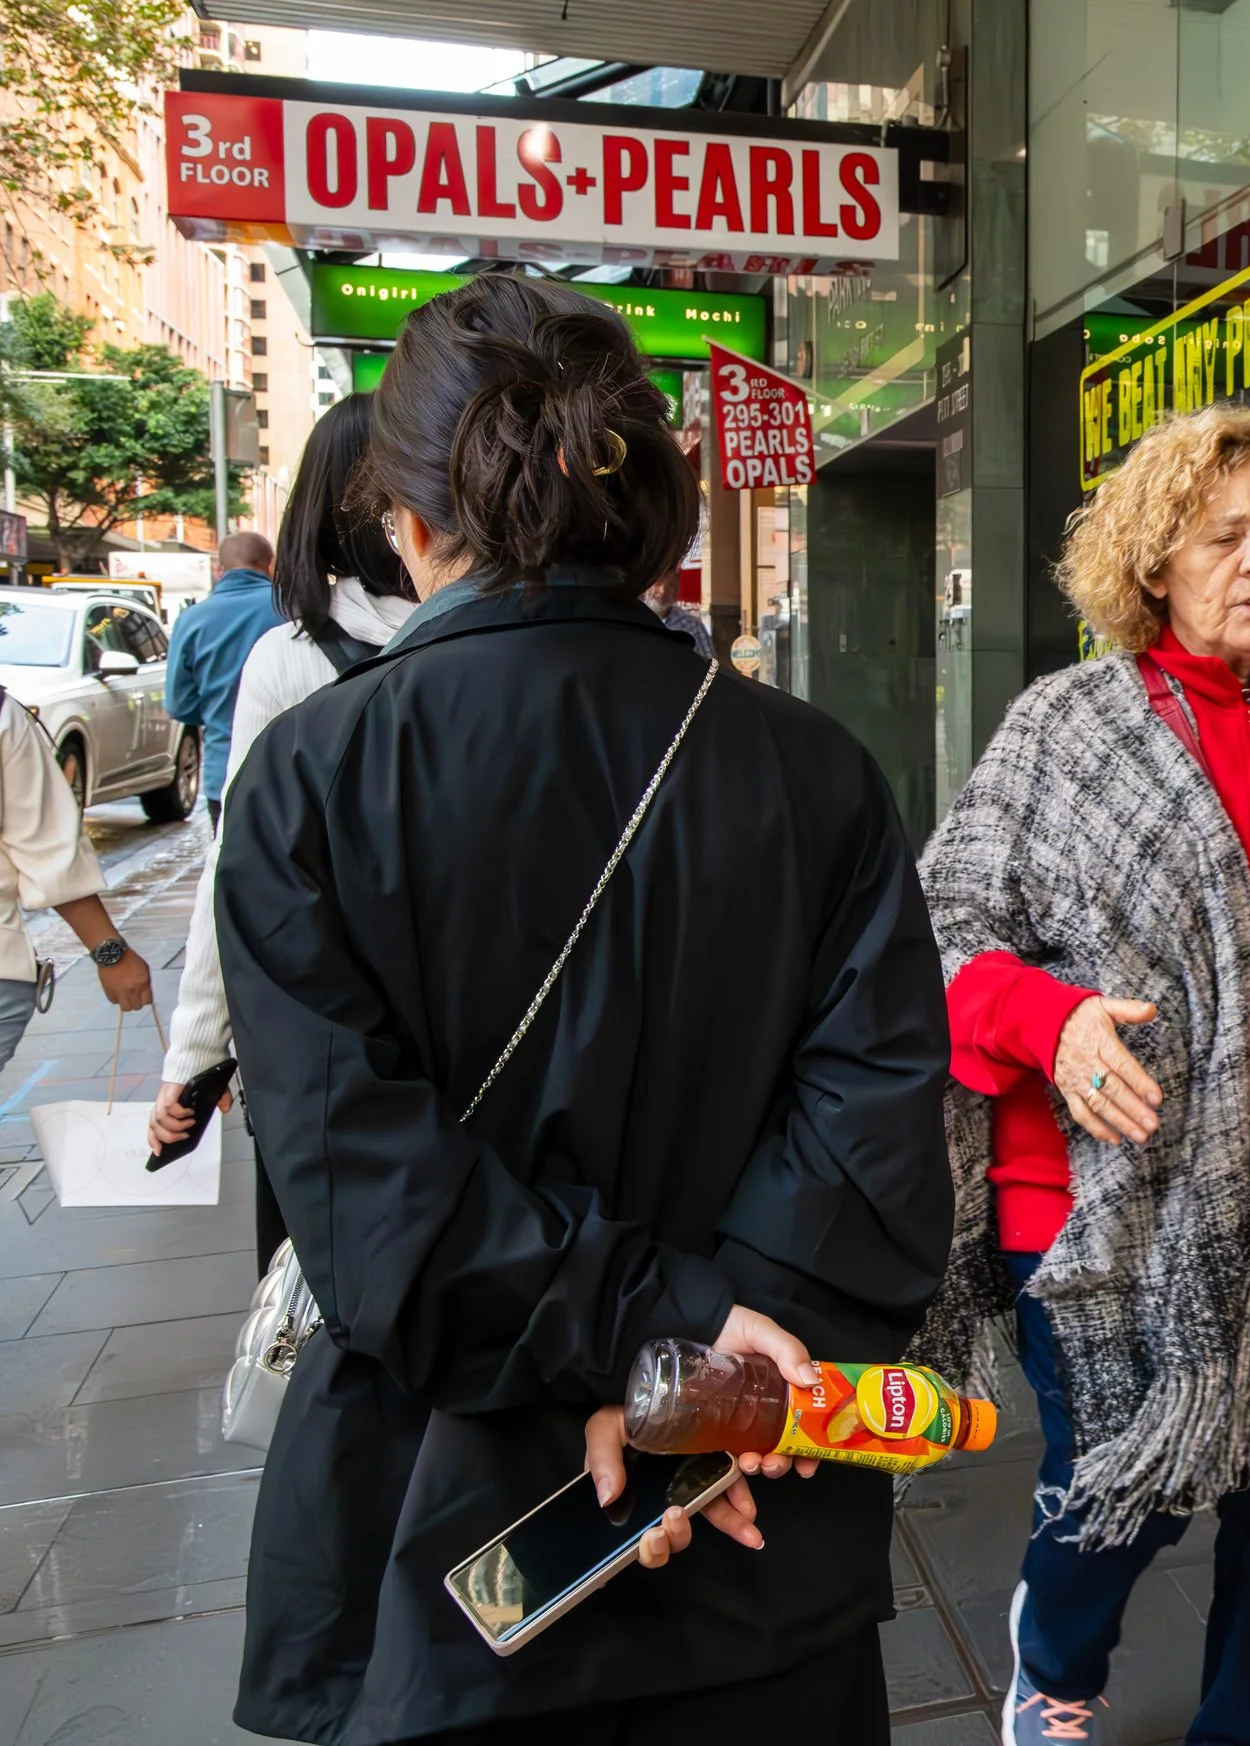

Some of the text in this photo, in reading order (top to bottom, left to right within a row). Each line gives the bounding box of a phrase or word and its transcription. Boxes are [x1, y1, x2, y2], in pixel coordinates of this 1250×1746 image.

[180, 114, 252, 160] 3rd
[180, 162, 270, 188] FLOOR
[341, 283, 418, 301] Onigiri
[685, 308, 741, 323] Mochi
[751, 388, 786, 400] FLOOR
[1084, 378, 1112, 462] WE
[1118, 346, 1167, 447] BEAT
[1175, 316, 1219, 416] ANY
[722, 400, 805, 429] 295-301
[724, 427, 809, 458] PEARLS
[726, 455, 813, 490] OPALS
[811, 1360, 826, 1408] PECH
[885, 1372, 906, 1429] Lipton
